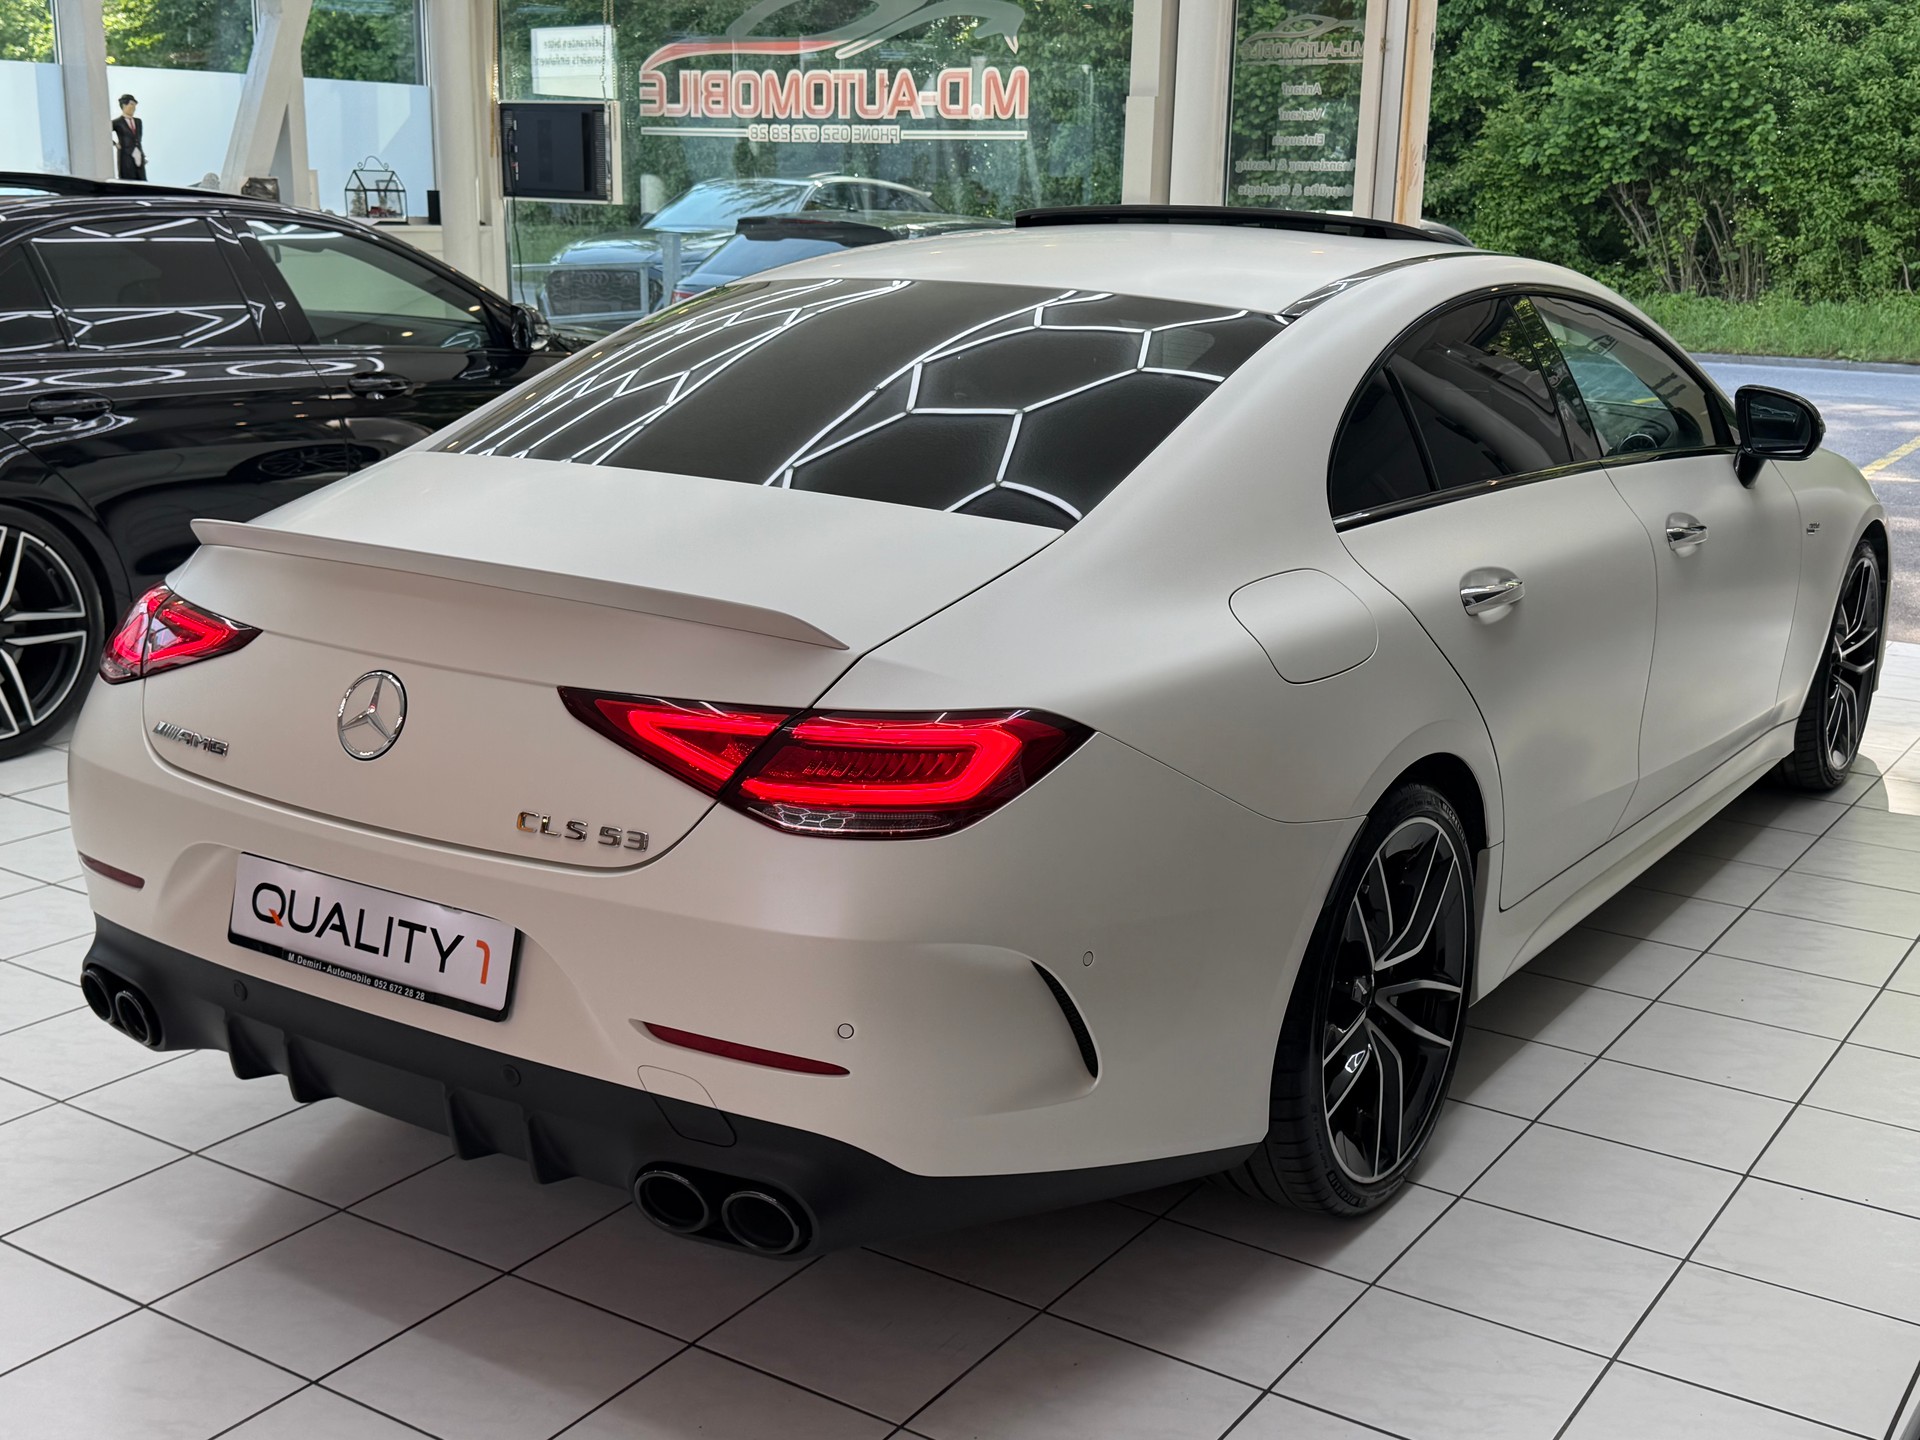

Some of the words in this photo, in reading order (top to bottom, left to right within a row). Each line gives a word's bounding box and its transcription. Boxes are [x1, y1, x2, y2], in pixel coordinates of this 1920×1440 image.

[516, 811, 588, 842] CLS
[598, 826, 649, 852] 53
[252, 882, 464, 973] QUALITY
[476, 940, 490, 984] 1
[374, 979, 387, 990] 052
[389, 983, 402, 995] 672
[404, 987, 414, 998] 28
[415, 991, 425, 1001] 28
